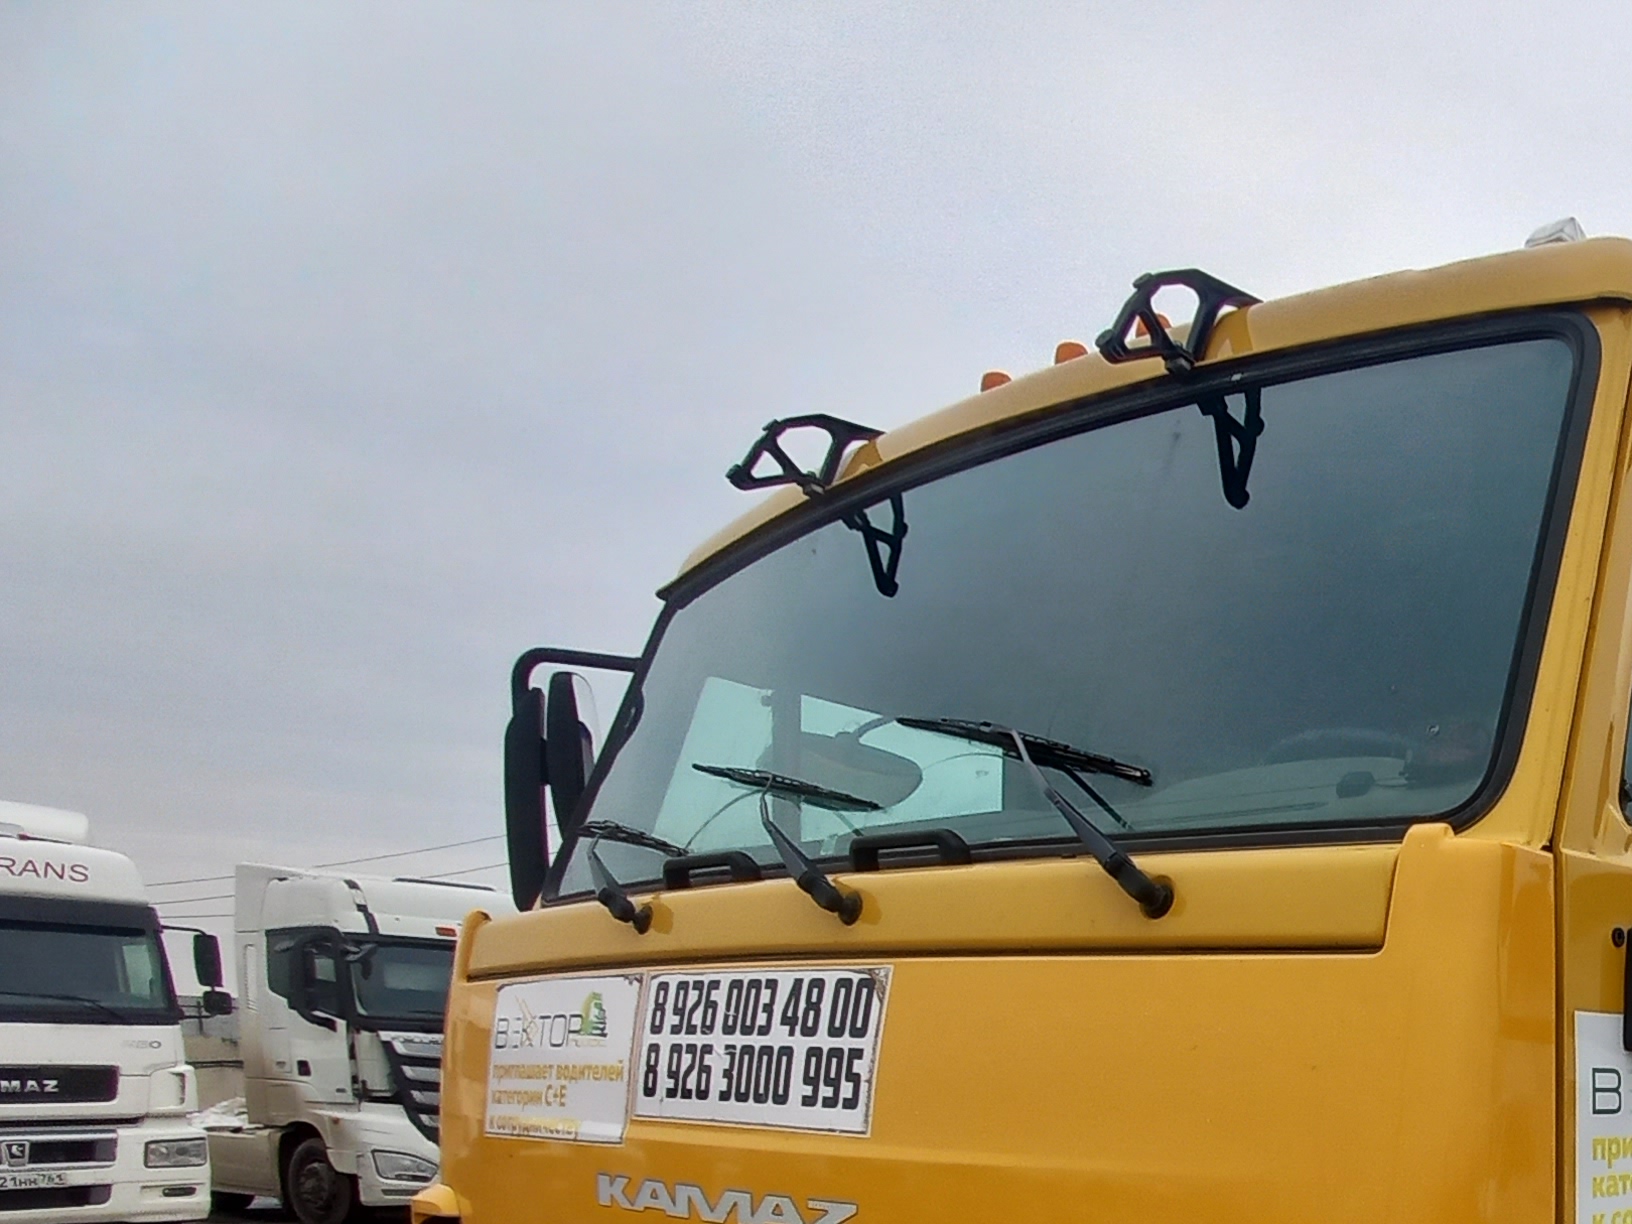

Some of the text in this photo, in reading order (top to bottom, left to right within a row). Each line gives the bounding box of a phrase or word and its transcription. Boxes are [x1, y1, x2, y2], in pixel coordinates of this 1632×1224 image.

[649, 978, 875, 1038] 8 926 003 48 00
[556, 1060, 624, 1084] водителей
[643, 1043, 864, 1110] 8 926 3000 995
